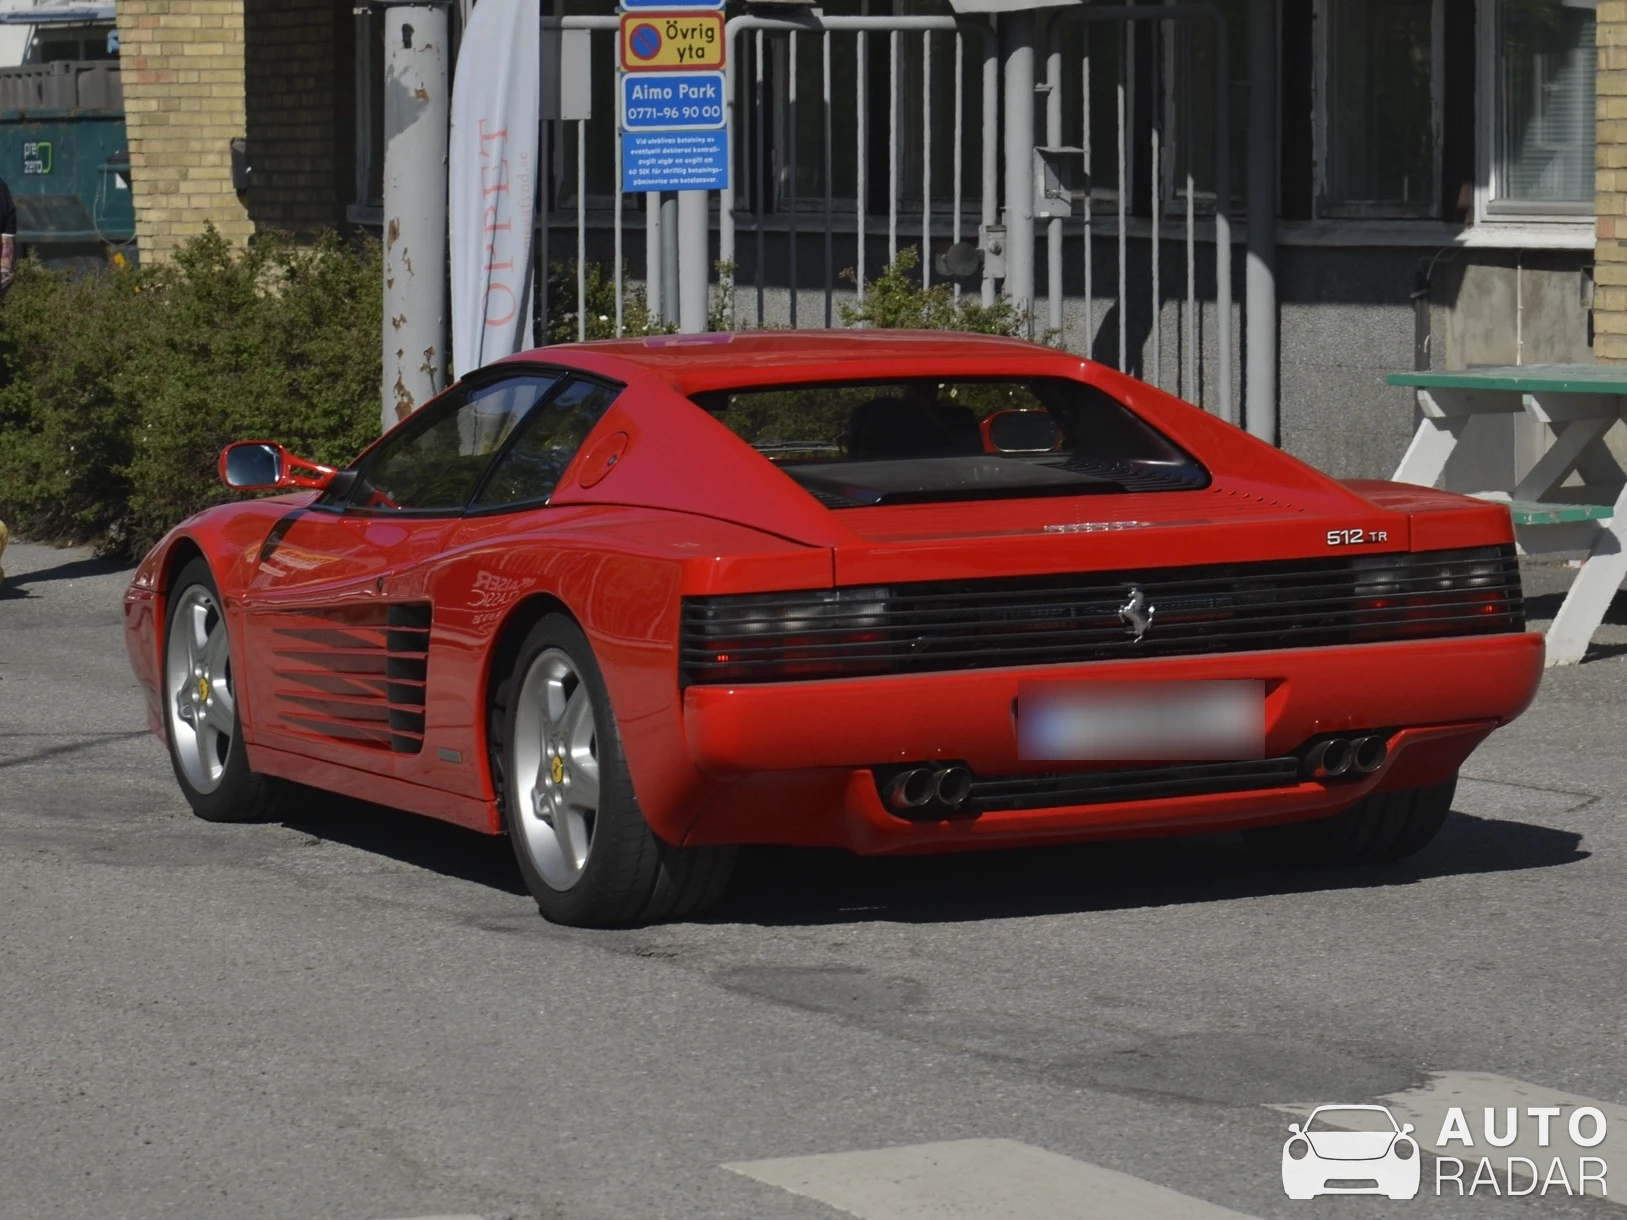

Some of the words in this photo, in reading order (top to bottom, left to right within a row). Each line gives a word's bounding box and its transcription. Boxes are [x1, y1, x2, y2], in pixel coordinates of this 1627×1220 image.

[665, 20, 715, 44] Övrig
[677, 44, 705, 63] yta
[632, 84, 673, 100] Aimo
[679, 83, 717, 99] Park
[628, 106, 680, 120] 0771-96
[682, 106, 700, 118] 90
[702, 105, 721, 118] 00
[677, 136, 706, 144] betalning
[638, 158, 657, 166] avgift
[684, 157, 703, 165] avgift
[663, 167, 687, 175] skriftlig
[633, 178, 668, 186] påminnelse
[1326, 528, 1365, 545] 512
[1368, 531, 1388, 542] TR
